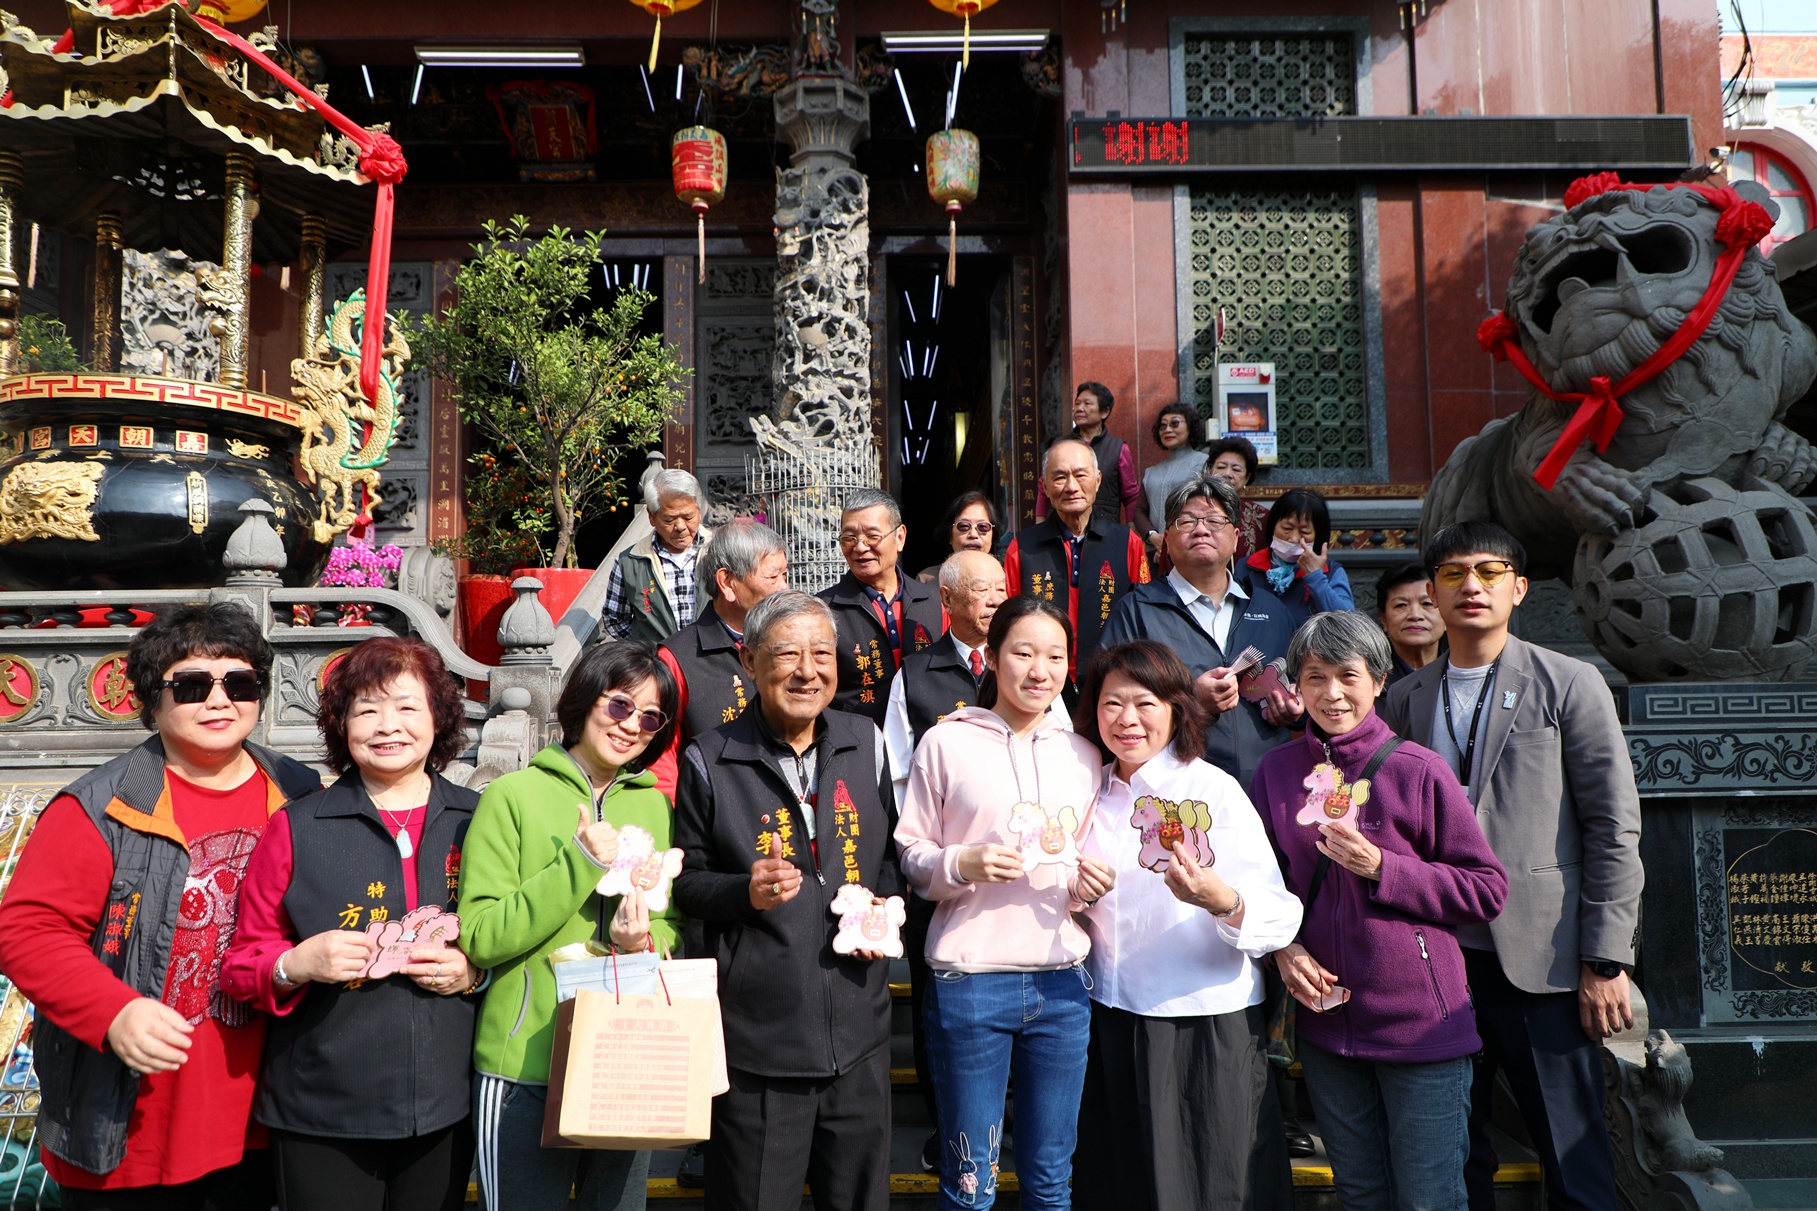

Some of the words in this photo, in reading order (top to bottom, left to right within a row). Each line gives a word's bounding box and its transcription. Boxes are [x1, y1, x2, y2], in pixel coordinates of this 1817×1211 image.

[1102, 121, 1189, 165] 謝謝
[855, 655, 876, 704] 郭在旗
[869, 639, 884, 679] 常務董事
[755, 830, 773, 856] 李
[775, 807, 797, 859] 董事長
[834, 813, 848, 839] 法人
[848, 811, 860, 837] 財團
[841, 838, 861, 884] 嘉邑朝
[366, 881, 389, 922] 特助
